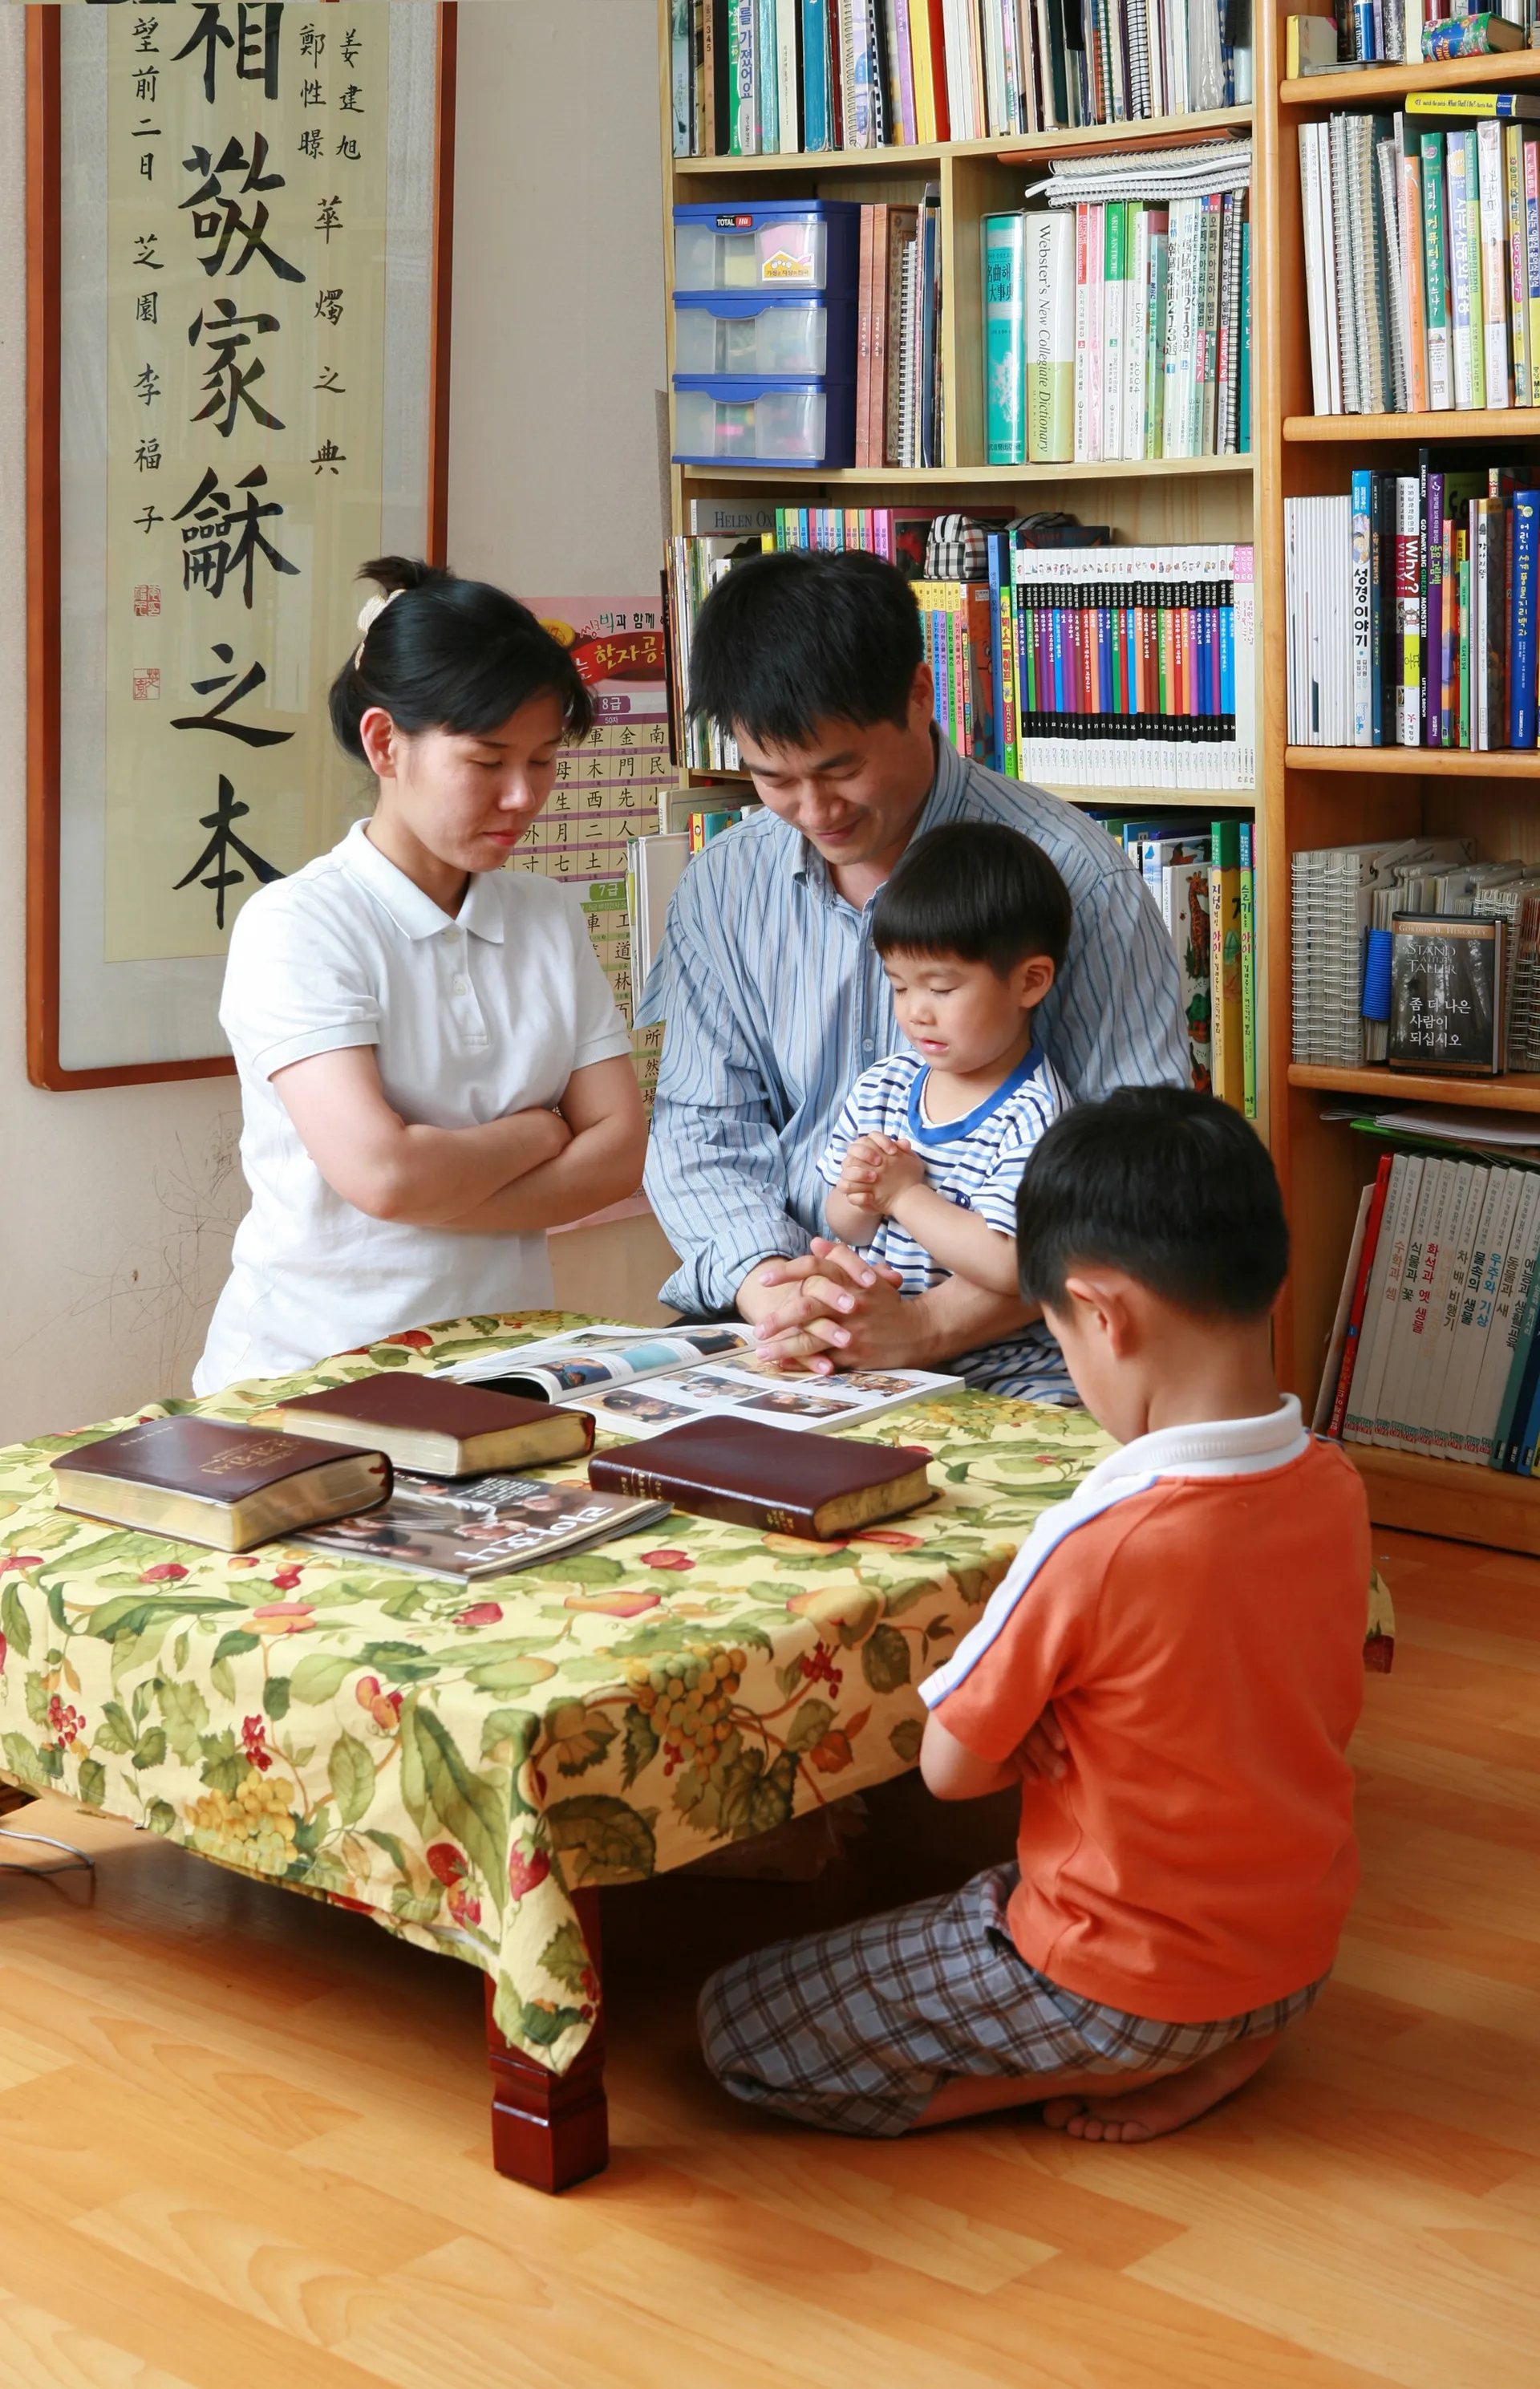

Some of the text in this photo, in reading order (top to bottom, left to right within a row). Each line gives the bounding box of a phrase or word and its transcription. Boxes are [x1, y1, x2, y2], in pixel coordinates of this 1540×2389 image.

[740, 31, 754, 99] 가졌어요
[717, 218, 735, 226] TOTAL
[1200, 217, 1208, 254] 오페라
[1427, 179, 1439, 316] 너희가 컴퓨터를 아느냐?
[1198, 260, 1206, 296] 아리아
[1207, 217, 1217, 327] 오페라 아리아 앨범
[1457, 284, 1469, 315] 활용
[1198, 302, 1205, 327] 앨범
[1034, 225, 1052, 452] Webster's New Collegiate Dictionary
[1196, 334, 1204, 367] 소프라노
[1133, 362, 1142, 394] 2004
[715, 510, 753, 528] HELEN
[1420, 519, 1427, 531] GO
[1519, 524, 1529, 570] 어린이 세계
[1405, 541, 1419, 594] Why?
[1430, 545, 1442, 585] 동요 그림책
[1478, 543, 1487, 579] 강아지똥
[1354, 568, 1368, 647] 성경이야기
[580, 612, 654, 639] 씽크빅과 함께
[602, 696, 622, 711] 8급
[587, 724, 665, 747] 軍 金 南
[556, 756, 666, 779] 母 木 門 民
[555, 789, 634, 811] 生 西 先
[523, 820, 634, 846] 外 月 二 人
[554, 853, 602, 873] 七 土
[598, 883, 619, 897] 7급
[587, 913, 600, 934] 車
[1399, 925, 1432, 933] GORDON
[1446, 927, 1486, 936] HINCKLEY
[614, 942, 631, 960] 道
[1407, 943, 1456, 956] STAND
[1407, 959, 1457, 975] TALLER
[614, 971, 631, 990] 林
[1409, 997, 1472, 1015] 좀 더 나은
[1409, 1015, 1449, 1030] 사람이
[644, 1028, 661, 1047] 所
[1409, 1032, 1462, 1048] 되십시오
[644, 1060, 659, 1077] 然
[1388, 1241, 1405, 1282] 수학과
[1401, 1243, 1423, 1302] 식물과 꽃
[1386, 1286, 1397, 1301] 셈
[1412, 1243, 1439, 1335] 화석과 옛 생물
[1461, 1251, 1486, 1326] 물속의 생물
[1476, 1252, 1502, 1328] 우주와 기상
[1496, 1256, 1519, 1318] 동물과 새
